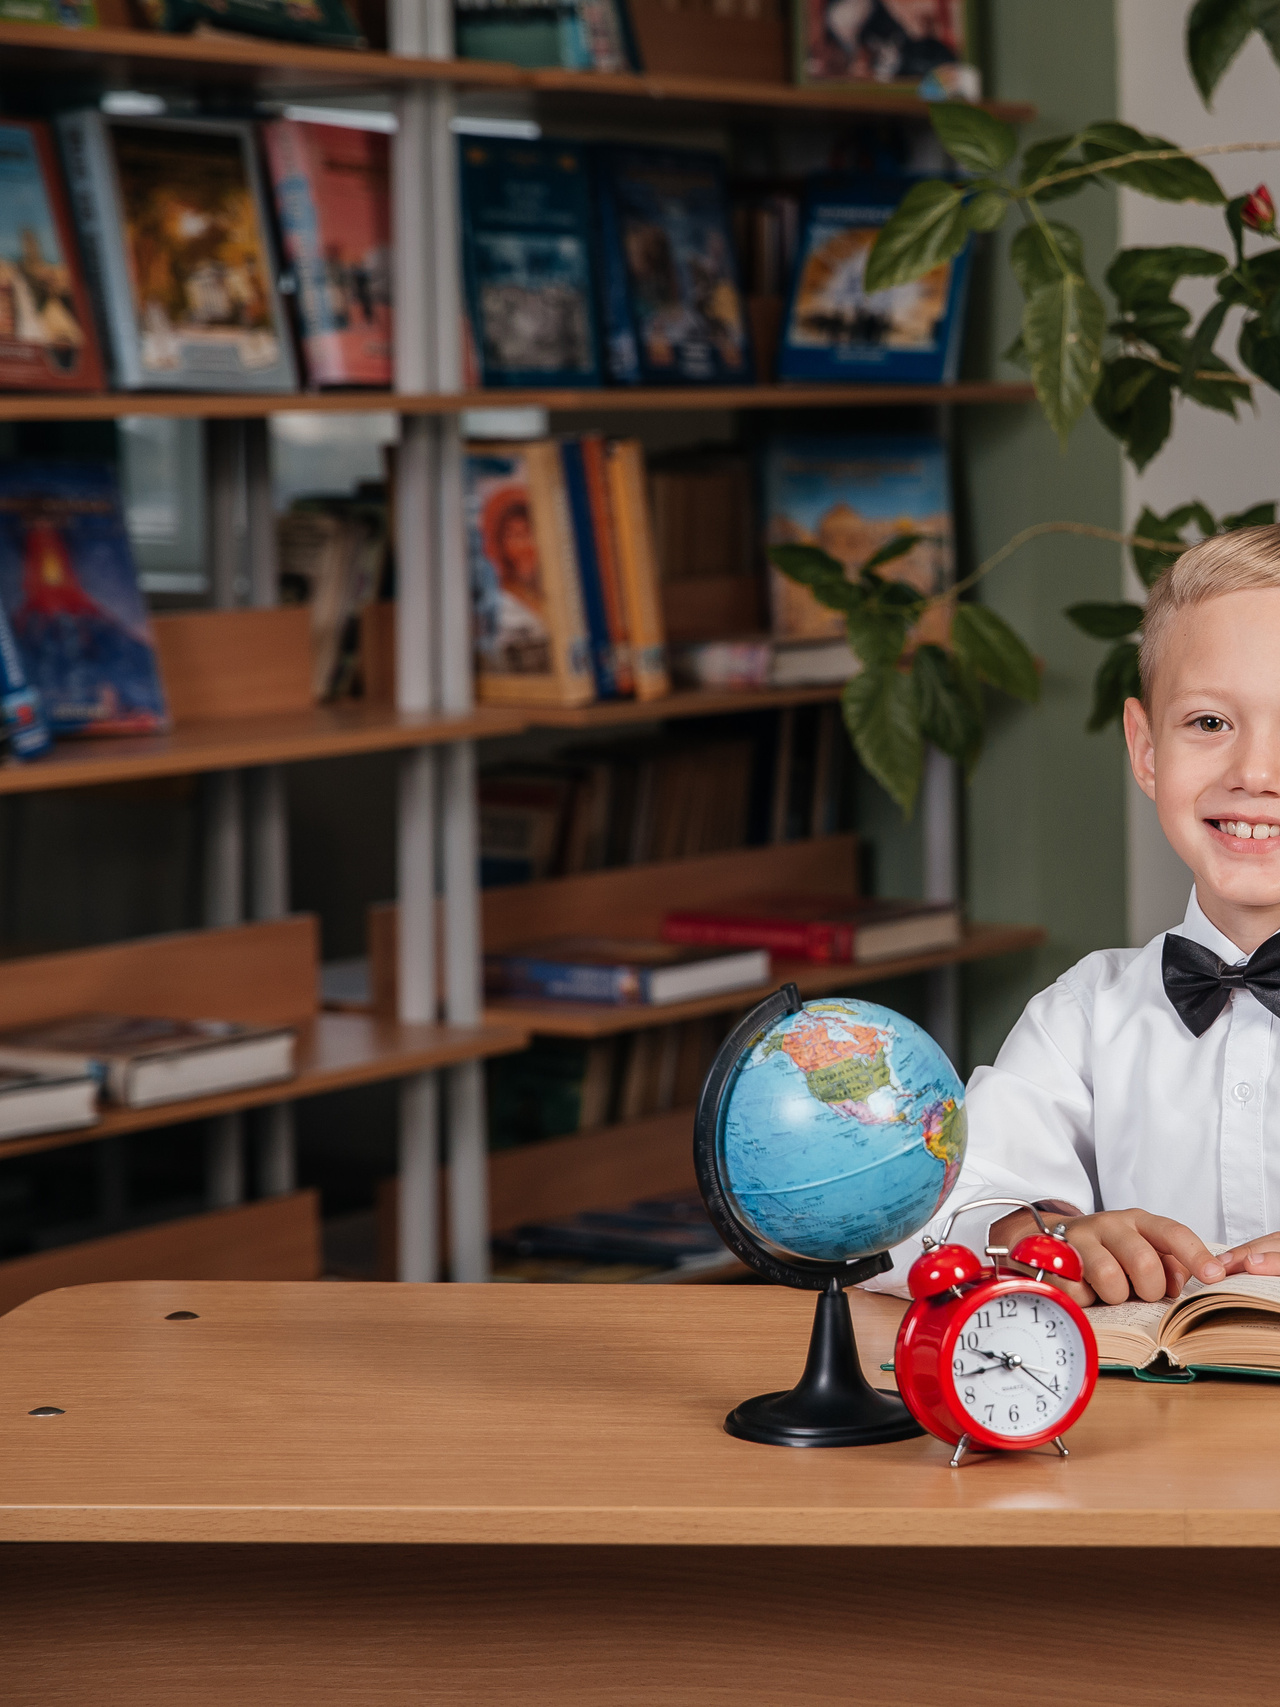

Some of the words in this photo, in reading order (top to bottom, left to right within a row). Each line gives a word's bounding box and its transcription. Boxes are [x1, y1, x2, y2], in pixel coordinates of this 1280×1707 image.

[997, 1299, 1017, 1318] 12
[1031, 1306, 1039, 1323] 1
[974, 1311, 992, 1329] 11
[1046, 1320, 1056, 1338] 2
[959, 1331, 979, 1351] 10
[1056, 1348, 1066, 1366] 3
[953, 1358, 964, 1377] 9
[1049, 1374, 1061, 1392] 4
[964, 1386, 976, 1405] 8
[1036, 1395, 1047, 1413] 5
[984, 1404, 994, 1421] 7
[1009, 1404, 1019, 1422] 6
